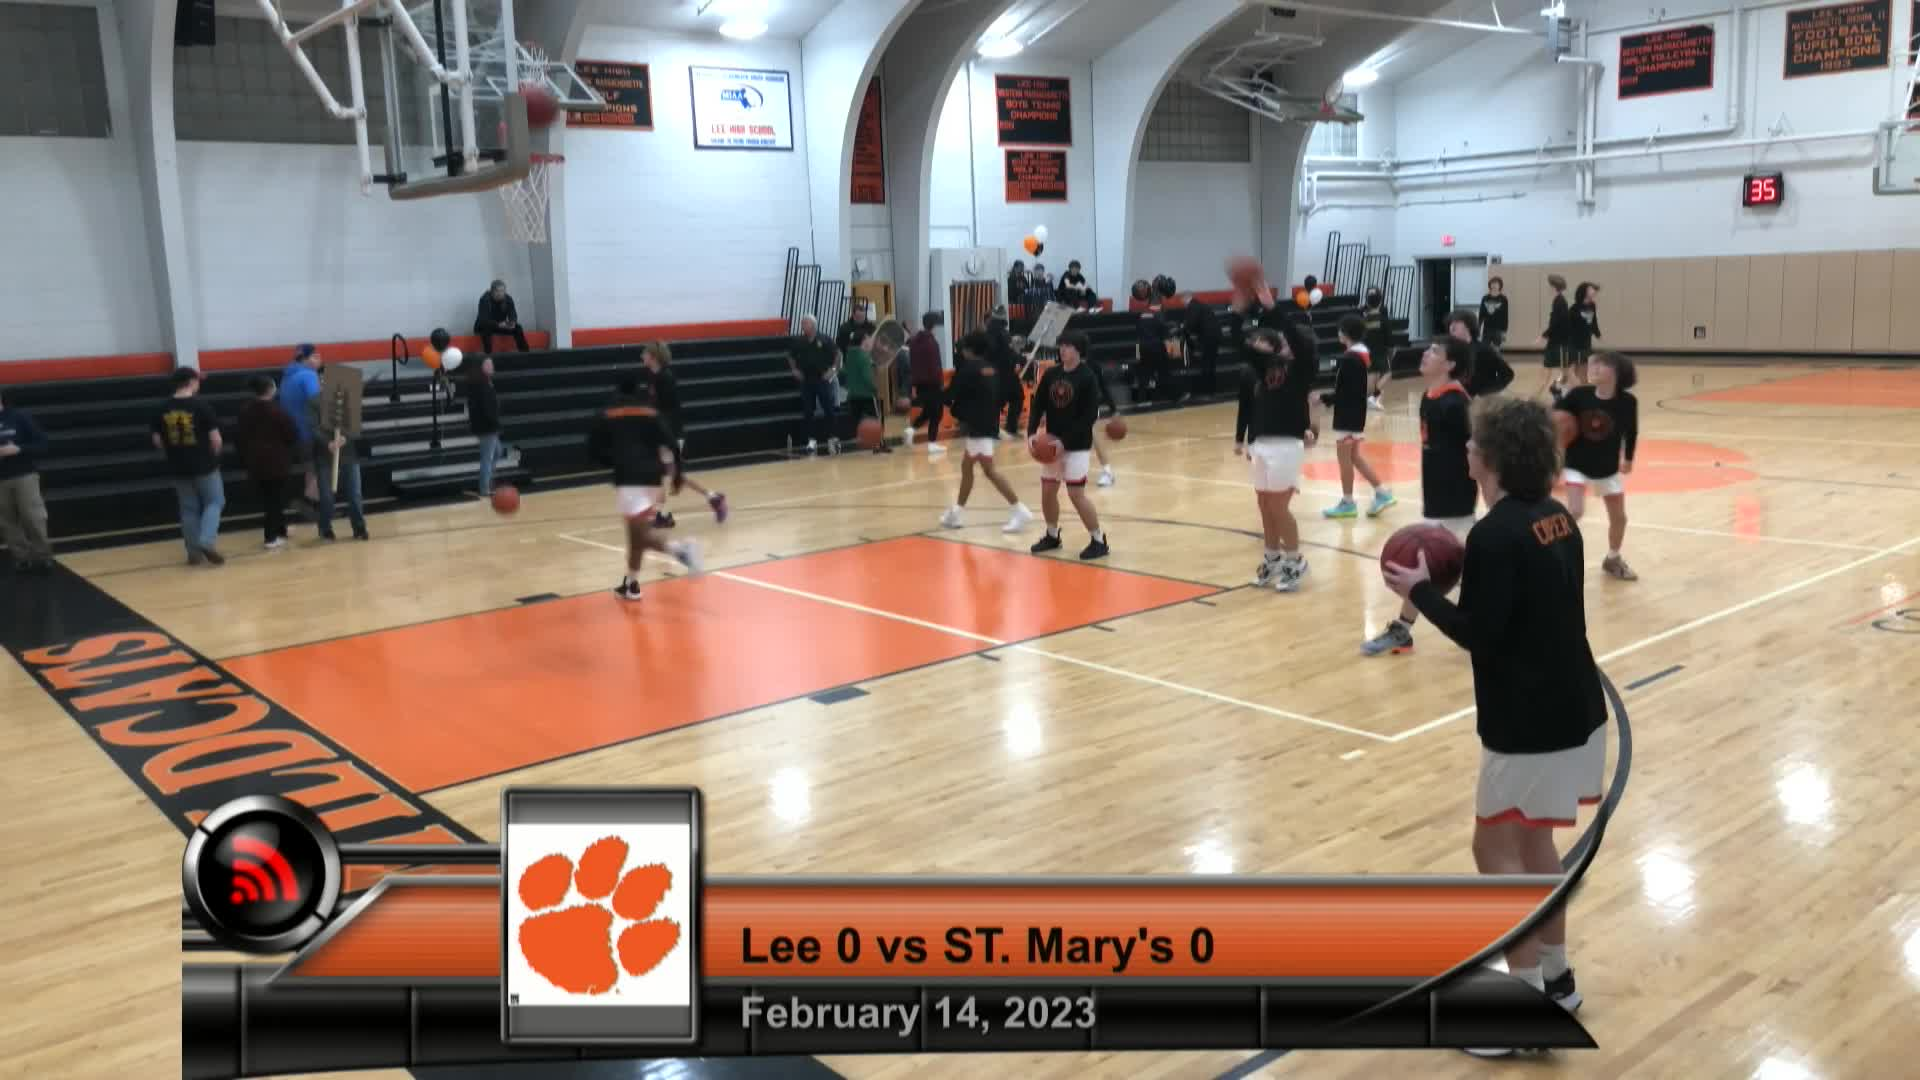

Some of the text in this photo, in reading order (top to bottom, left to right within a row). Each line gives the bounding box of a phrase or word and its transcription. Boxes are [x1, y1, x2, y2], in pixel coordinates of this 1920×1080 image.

[1794, 22, 1881, 40] FOOTBALL
[1793, 32, 1881, 53] SUPER BOWL
[1793, 43, 1881, 64] CHAMPIONS
[1751, 178, 1775, 201] 35
